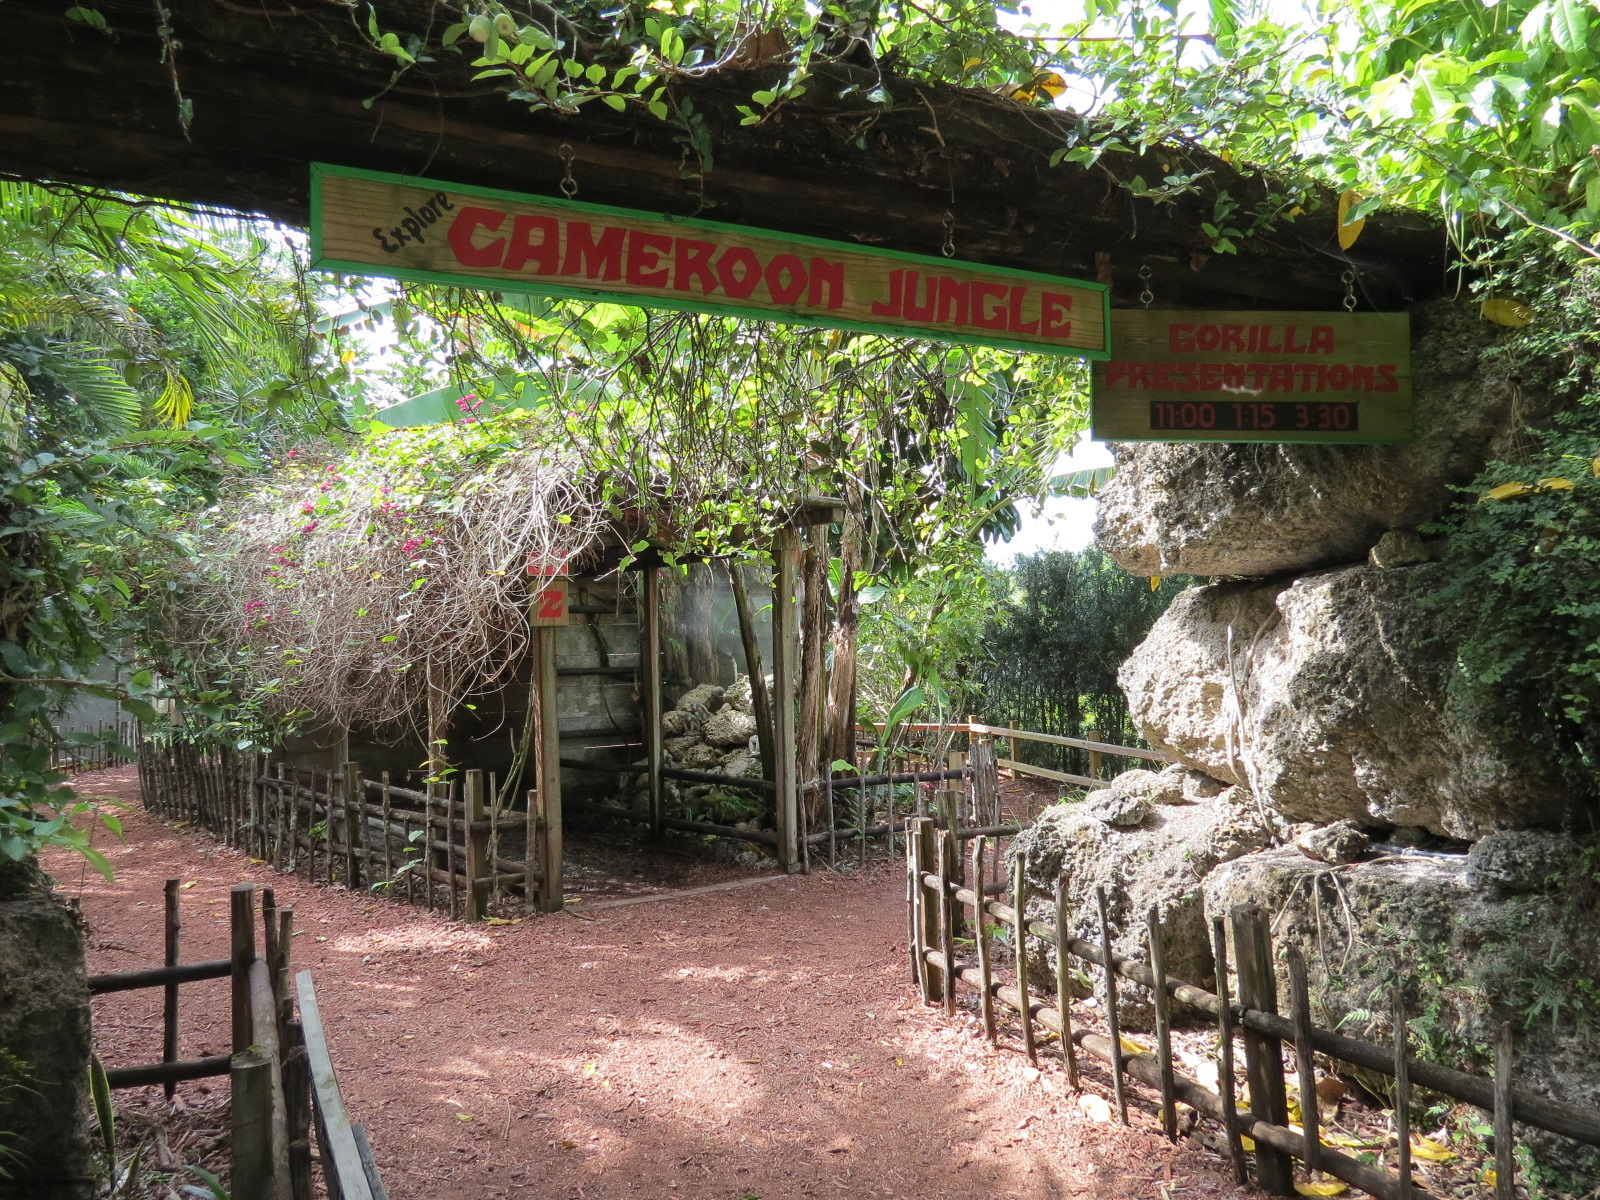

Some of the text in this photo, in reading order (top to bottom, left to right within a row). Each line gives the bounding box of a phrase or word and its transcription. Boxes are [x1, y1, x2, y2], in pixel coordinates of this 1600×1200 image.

[373, 192, 454, 253] Explore
[447, 206, 1072, 338] CAMEROON JUNGLE
[1169, 323, 1334, 353] GORILLA
[1105, 362, 1398, 392] PRESENTATIONS
[1155, 403, 1349, 428] 11:00 1:15 3:30
